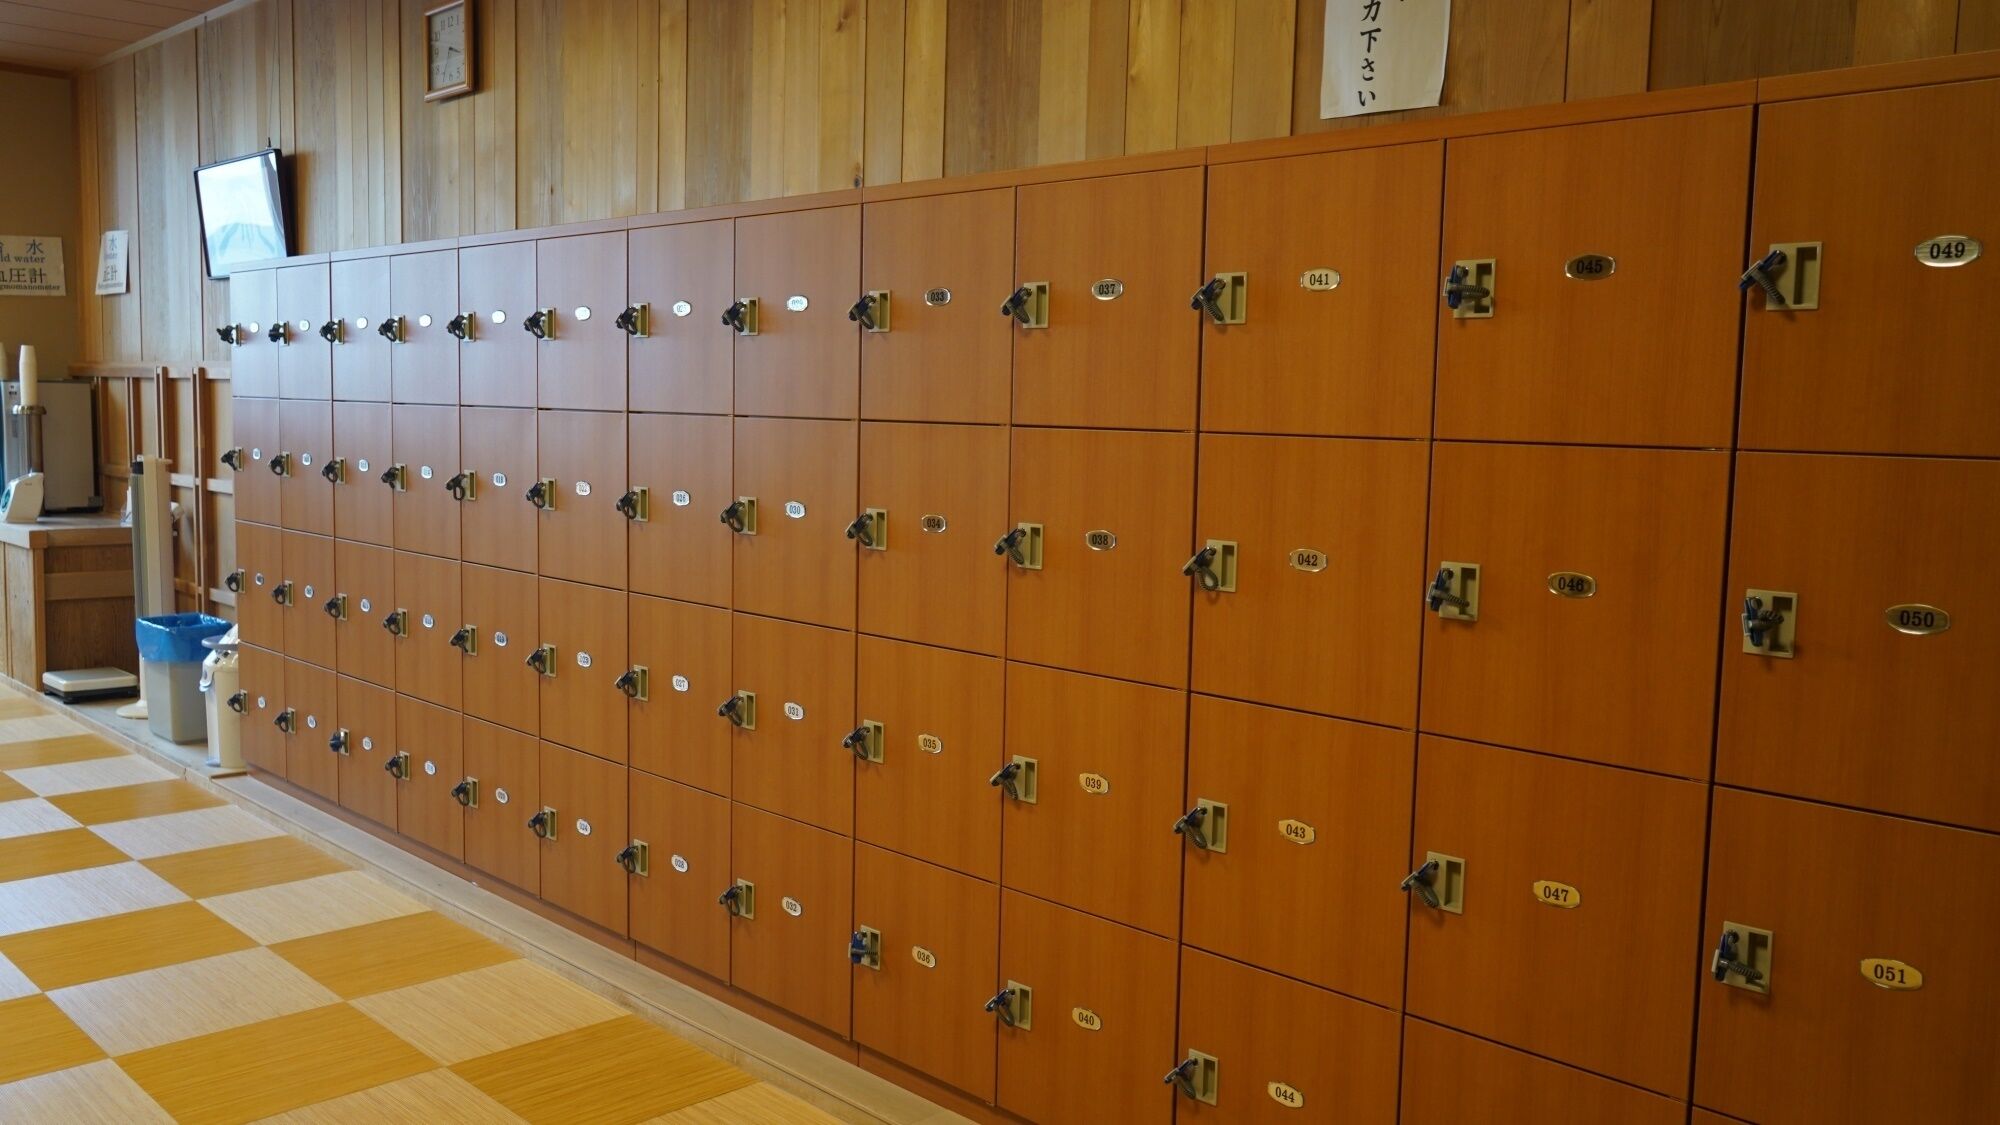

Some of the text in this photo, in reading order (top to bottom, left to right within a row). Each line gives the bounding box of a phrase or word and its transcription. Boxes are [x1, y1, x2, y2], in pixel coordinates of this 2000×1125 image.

[1930, 242, 1965, 259] 049
[14, 255, 45, 263] water
[1576, 259, 1602, 274] 045
[1309, 273, 1329, 286] 041
[1099, 284, 1115, 294] 037
[931, 292, 944, 301] 033
[927, 519, 940, 528] 034
[1092, 534, 1108, 545] 038
[1298, 553, 1318, 566] 042
[1558, 577, 1584, 592] 046
[1900, 610, 1935, 627] 050
[923, 738, 937, 749] 035
[1086, 777, 1101, 789] 039
[1286, 824, 1305, 839] 043
[1544, 885, 1569, 902] 047
[917, 951, 930, 963] 036
[1874, 964, 1905, 984] 051
[1079, 1012, 1094, 1025] 040
[1275, 1087, 1295, 1102] 044
